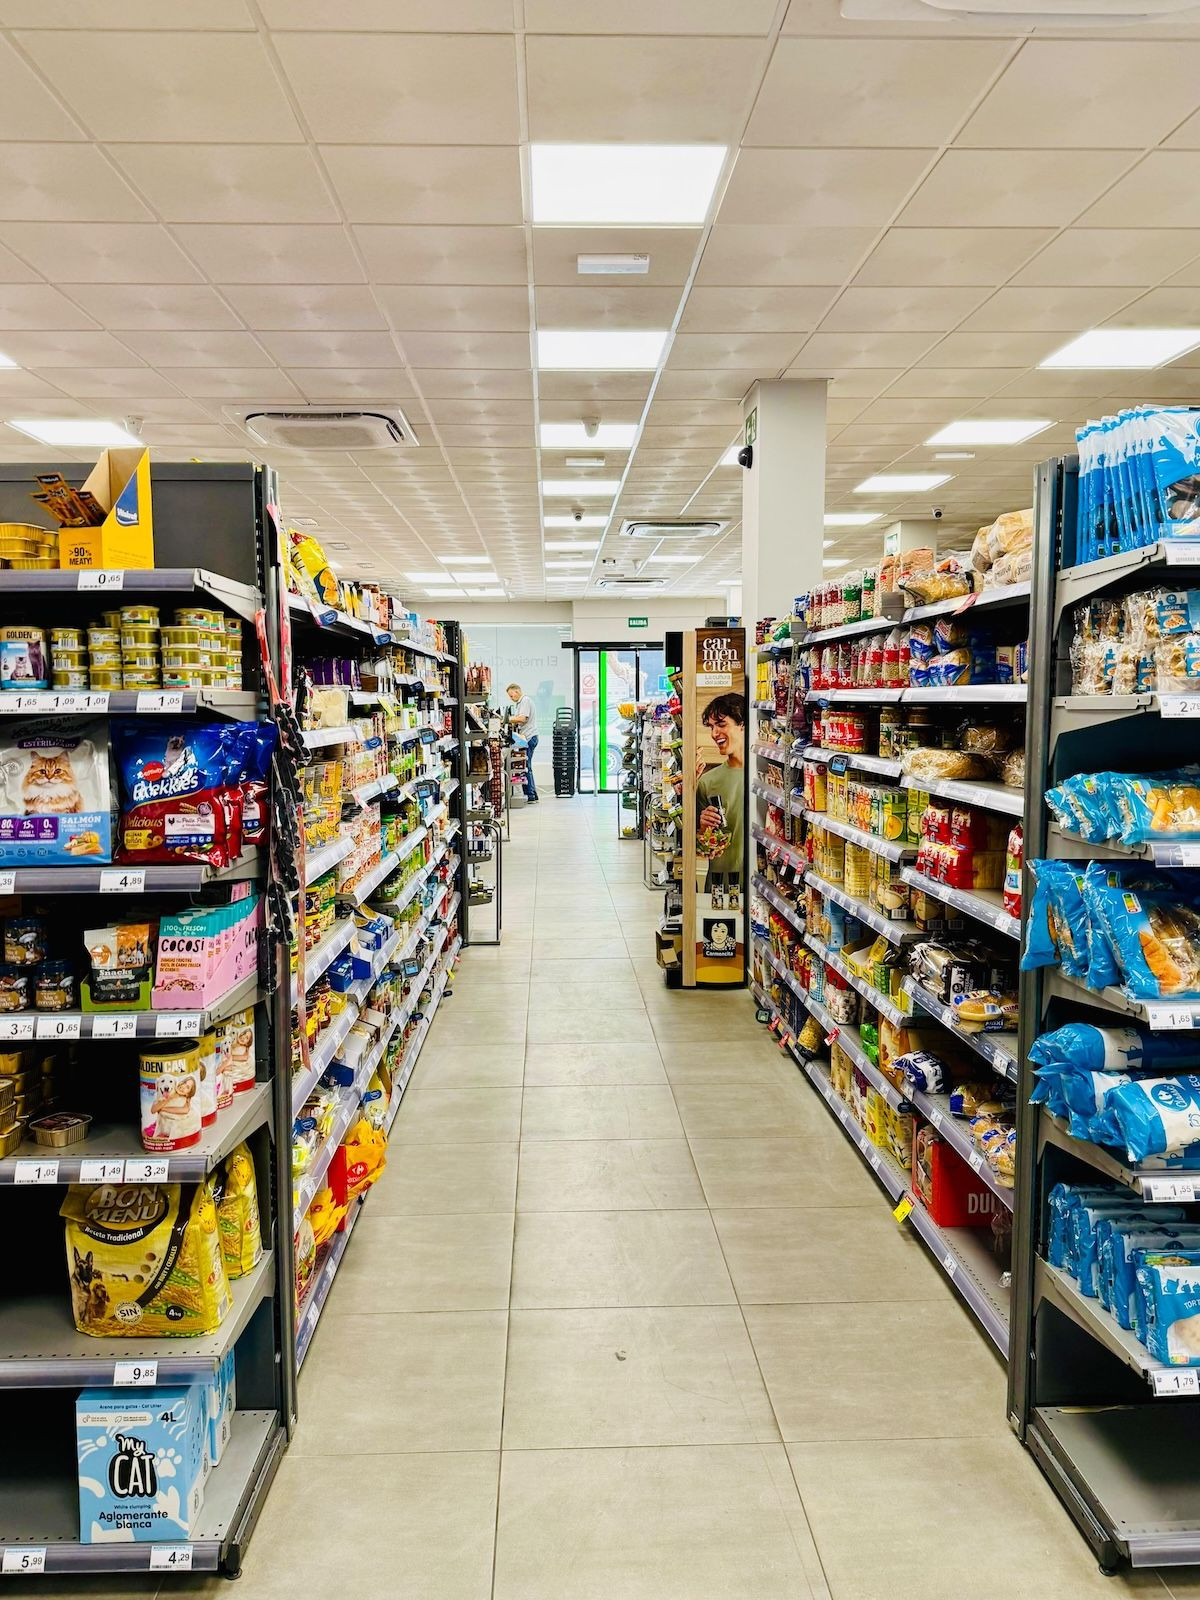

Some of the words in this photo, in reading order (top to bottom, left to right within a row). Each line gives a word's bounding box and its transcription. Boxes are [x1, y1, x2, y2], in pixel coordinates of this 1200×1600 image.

[98, 574, 120, 584] 0,65
[6, 631, 32, 639] GOLDEN
[16, 697, 37, 708] 1,65
[54, 696, 75, 708] 1,09
[84, 696, 106, 707] 1,09
[158, 696, 180, 706] 1,05
[61, 815, 102, 824] SALMÓN
[120, 876, 142, 886] 4,89
[176, 1019, 198, 1031] 1,95
[1168, 1014, 1190, 1025] 1,65
[10, 1024, 32, 1035] 3,75
[56, 1022, 78, 1034] 0,65
[112, 1022, 134, 1032] 1,39
[34, 1167, 56, 1179] 1,05
[100, 1166, 121, 1177] 1,49
[144, 1166, 166, 1176] 3,29
[1170, 1184, 1192, 1196] 1,55
[98, 1184, 158, 1208] BON
[84, 1226, 106, 1238] Receta
[106, 1228, 144, 1242] Tradicional
[120, 1308, 138, 1318] SIN
[132, 1368, 155, 1380] 9,85
[1174, 1376, 1194, 1388] 1,79
[160, 1412, 176, 1422] 4L
[118, 1436, 146, 1456] My
[114, 1454, 154, 1494] CAT
[98, 1510, 168, 1522] Aglomerante
[116, 1520, 152, 1529] blanca
[21, 1556, 43, 1568] 5,99
[168, 1552, 190, 1564] 4,29
